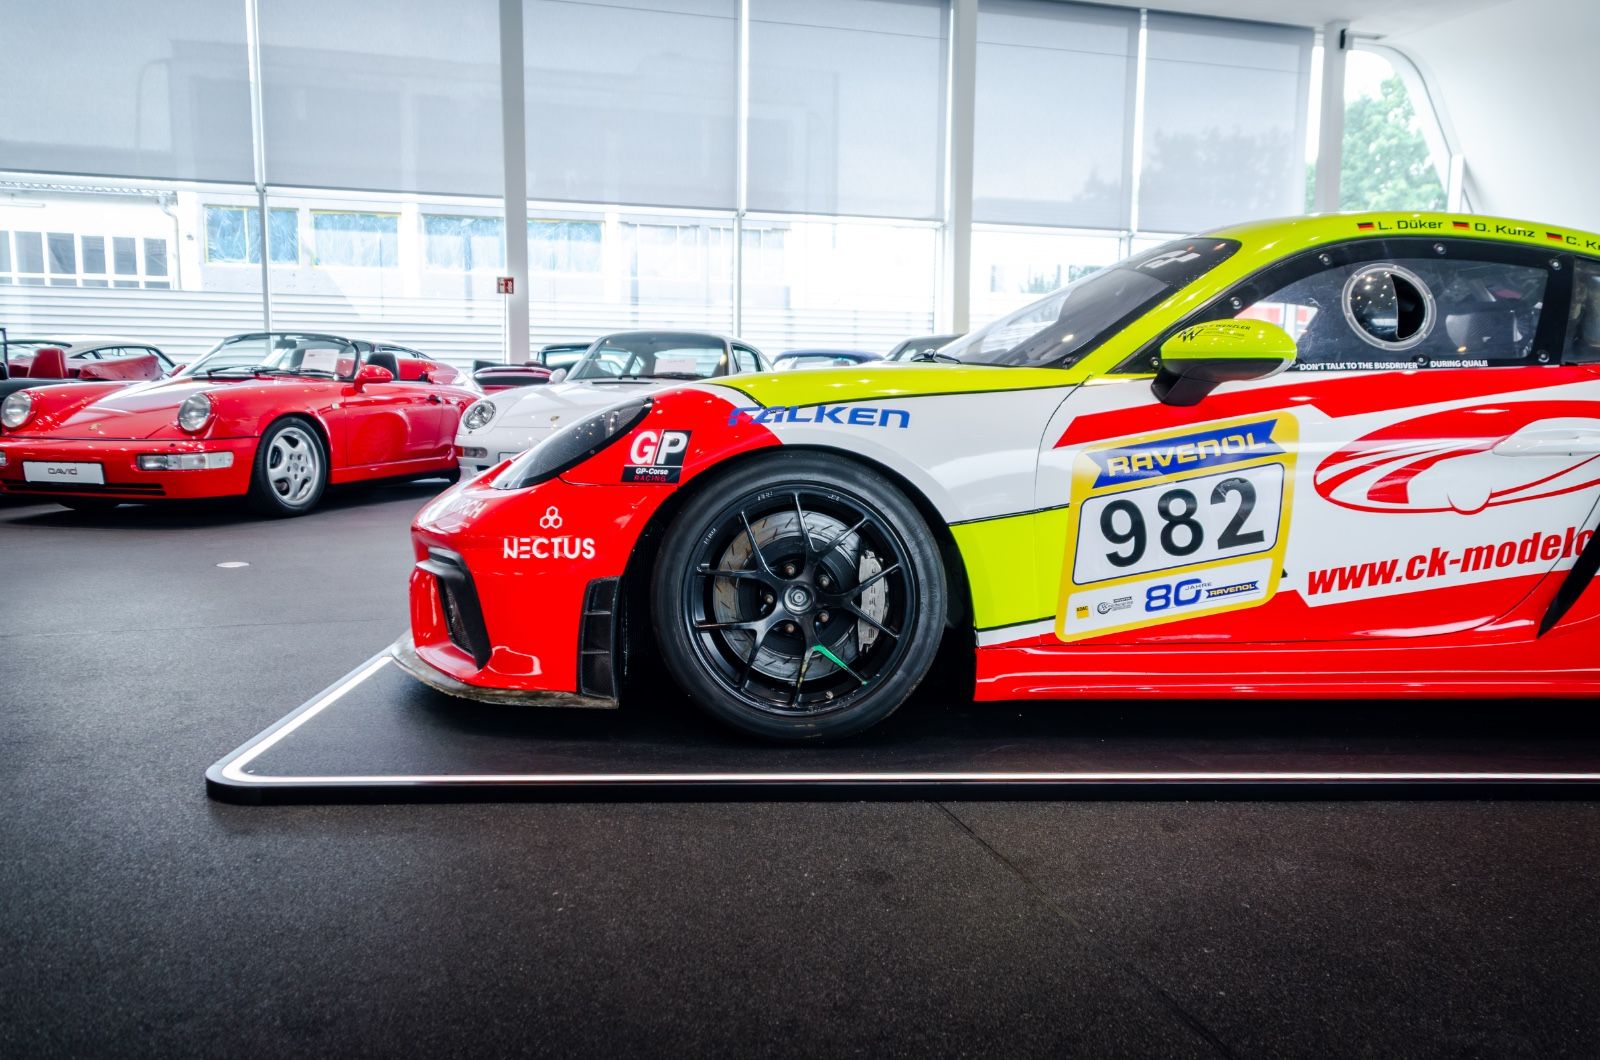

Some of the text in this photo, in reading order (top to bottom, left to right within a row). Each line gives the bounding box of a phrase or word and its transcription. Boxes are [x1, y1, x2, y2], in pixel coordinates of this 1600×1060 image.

[1378, 221, 1393, 230] L.
[1397, 219, 1443, 230] Düker
[1496, 224, 1536, 238] Kunz
[1566, 235, 1581, 247] C.
[1586, 240, 1600, 251] K
[1299, 361, 1419, 371] DON'T TALK TO THE BUSDRIVER
[1430, 360, 1460, 368] DURING
[728, 405, 911, 429] FALKEN
[630, 430, 688, 465] GP
[1106, 432, 1268, 477] RAVENOL
[635, 467, 669, 475] GP-Corse
[1100, 477, 1265, 567] 982
[502, 537, 596, 560] NECTUS
[1145, 578, 1203, 613] 80
[1209, 583, 1257, 597] RAVENOL
